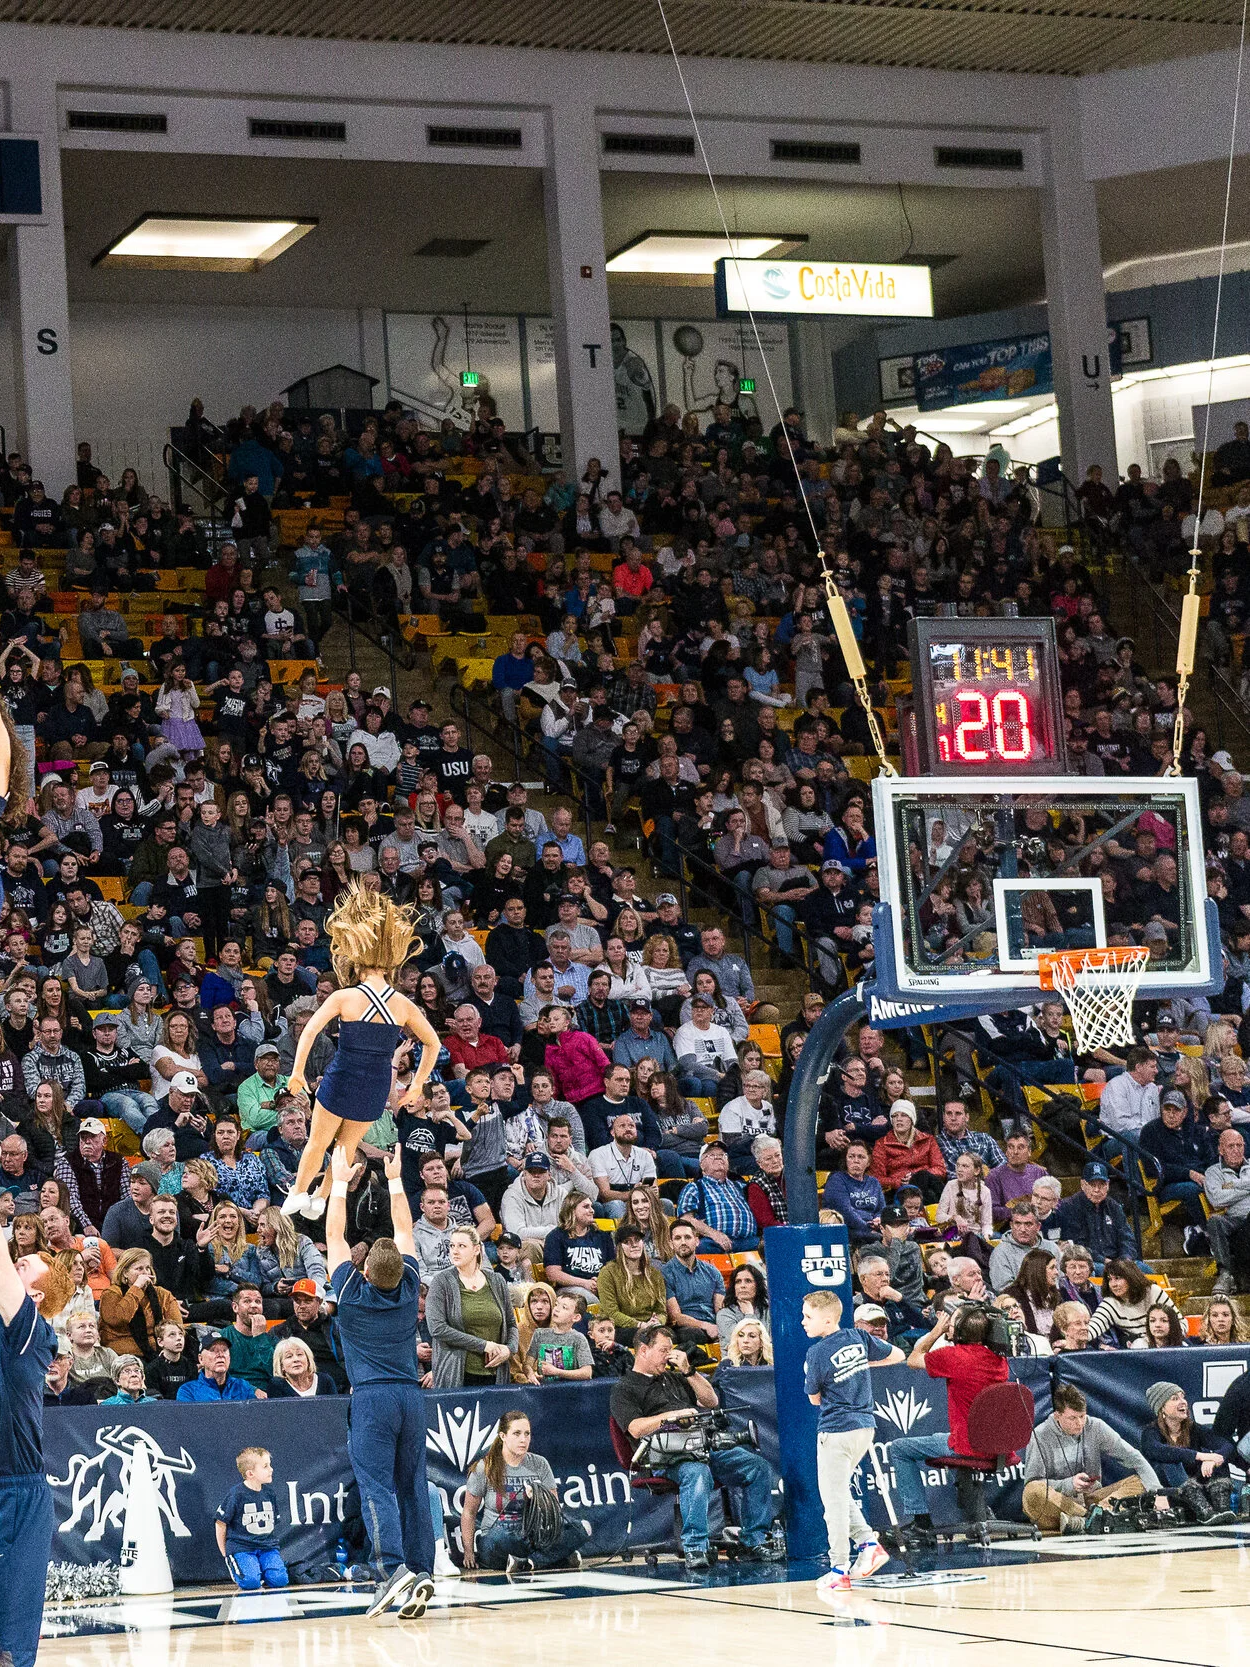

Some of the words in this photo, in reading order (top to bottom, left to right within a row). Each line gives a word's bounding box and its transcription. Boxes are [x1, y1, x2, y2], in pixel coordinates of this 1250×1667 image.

[37, 328, 59, 355] S
[988, 345, 1017, 363] TOP
[1019, 335, 1050, 355] THIS
[583, 344, 601, 368] T
[1082, 355, 1099, 378] U
[464, 372, 479, 384] EXIT
[741, 379, 755, 391] EXIT
[953, 649, 1035, 681] 11:41
[956, 692, 1031, 760] 20
[442, 761, 469, 777] USU
[908, 978, 940, 987] SPALDING
[801, 1256, 847, 1273] STATE
[299, 1280, 306, 1290] S
